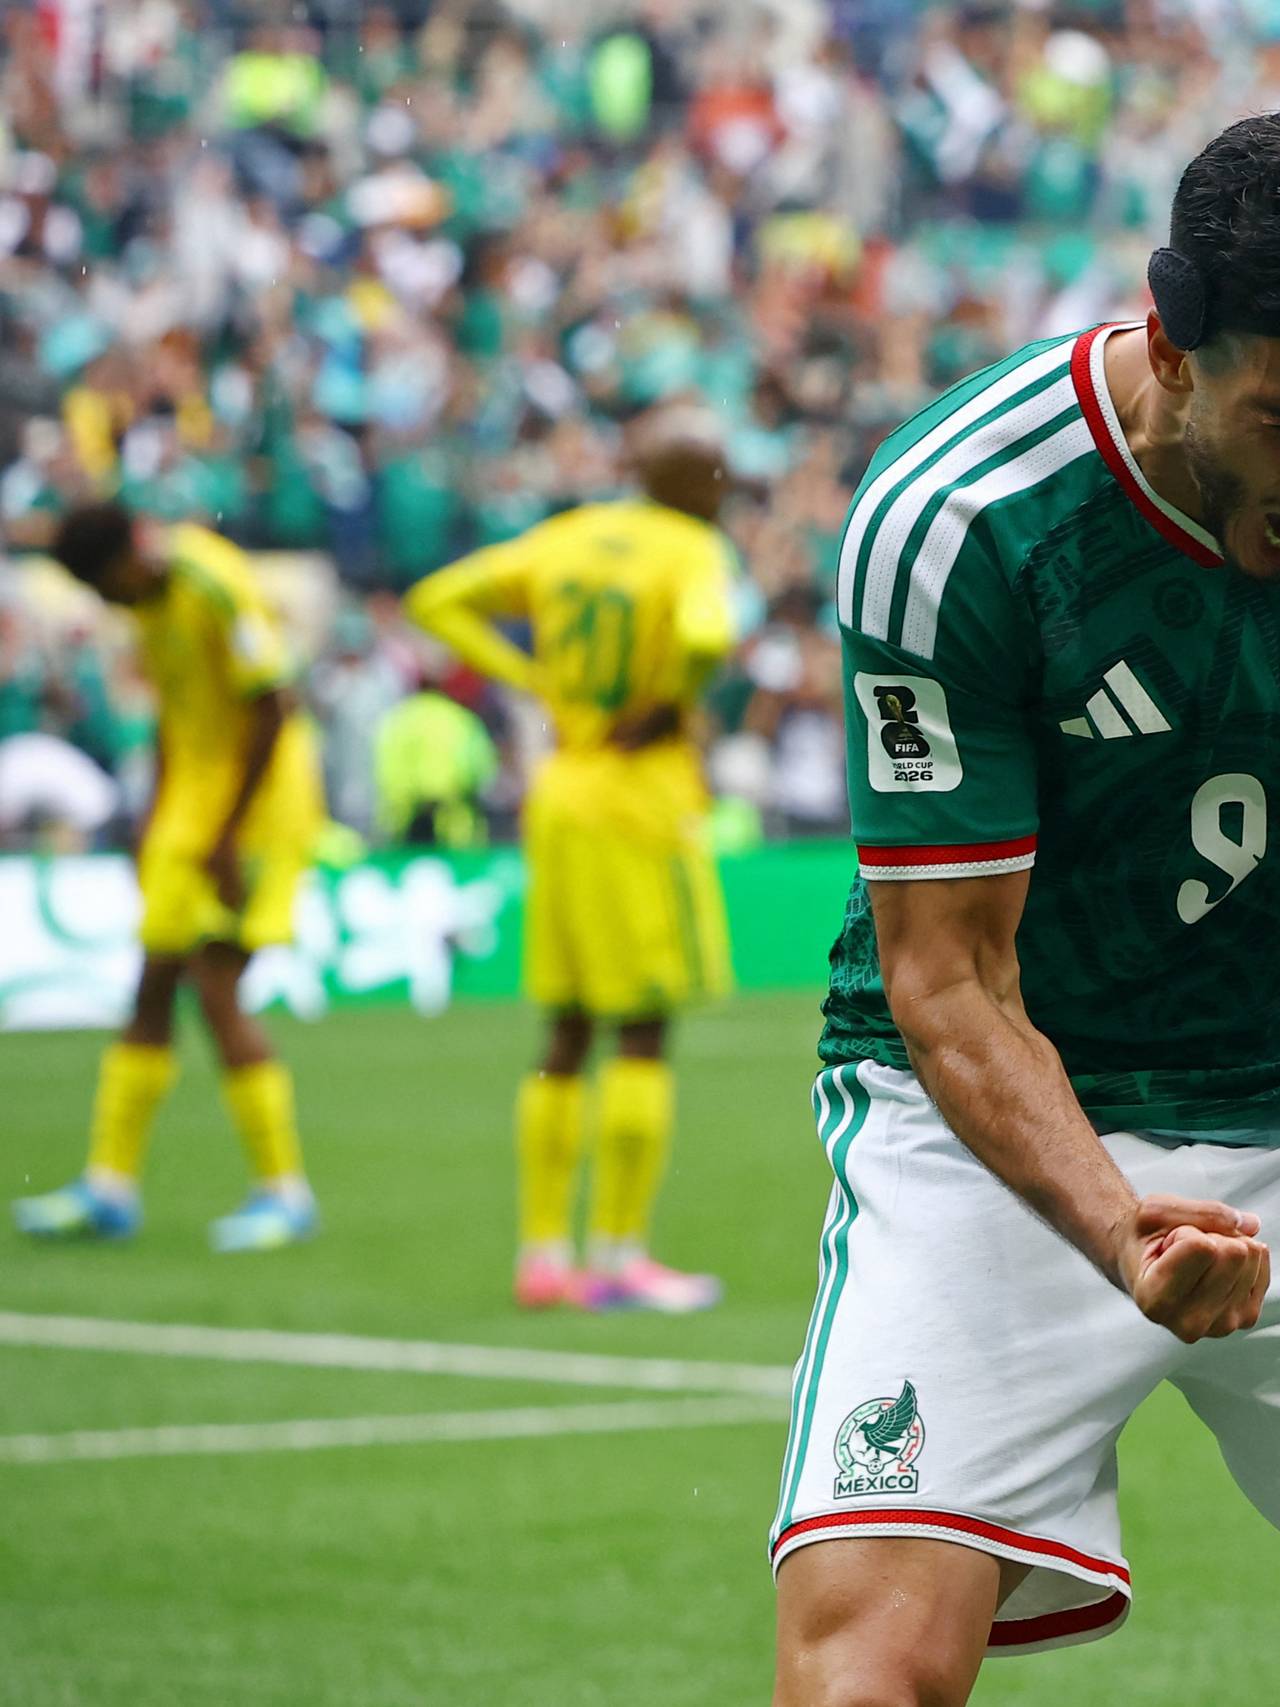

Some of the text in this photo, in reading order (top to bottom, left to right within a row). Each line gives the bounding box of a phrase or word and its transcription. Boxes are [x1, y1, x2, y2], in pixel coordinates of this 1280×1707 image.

[895, 743, 920, 753] FIFA
[915, 761, 934, 769] CUP
[1176, 773, 1267, 925] 9
[837, 1474, 914, 1495] MÉXICO
